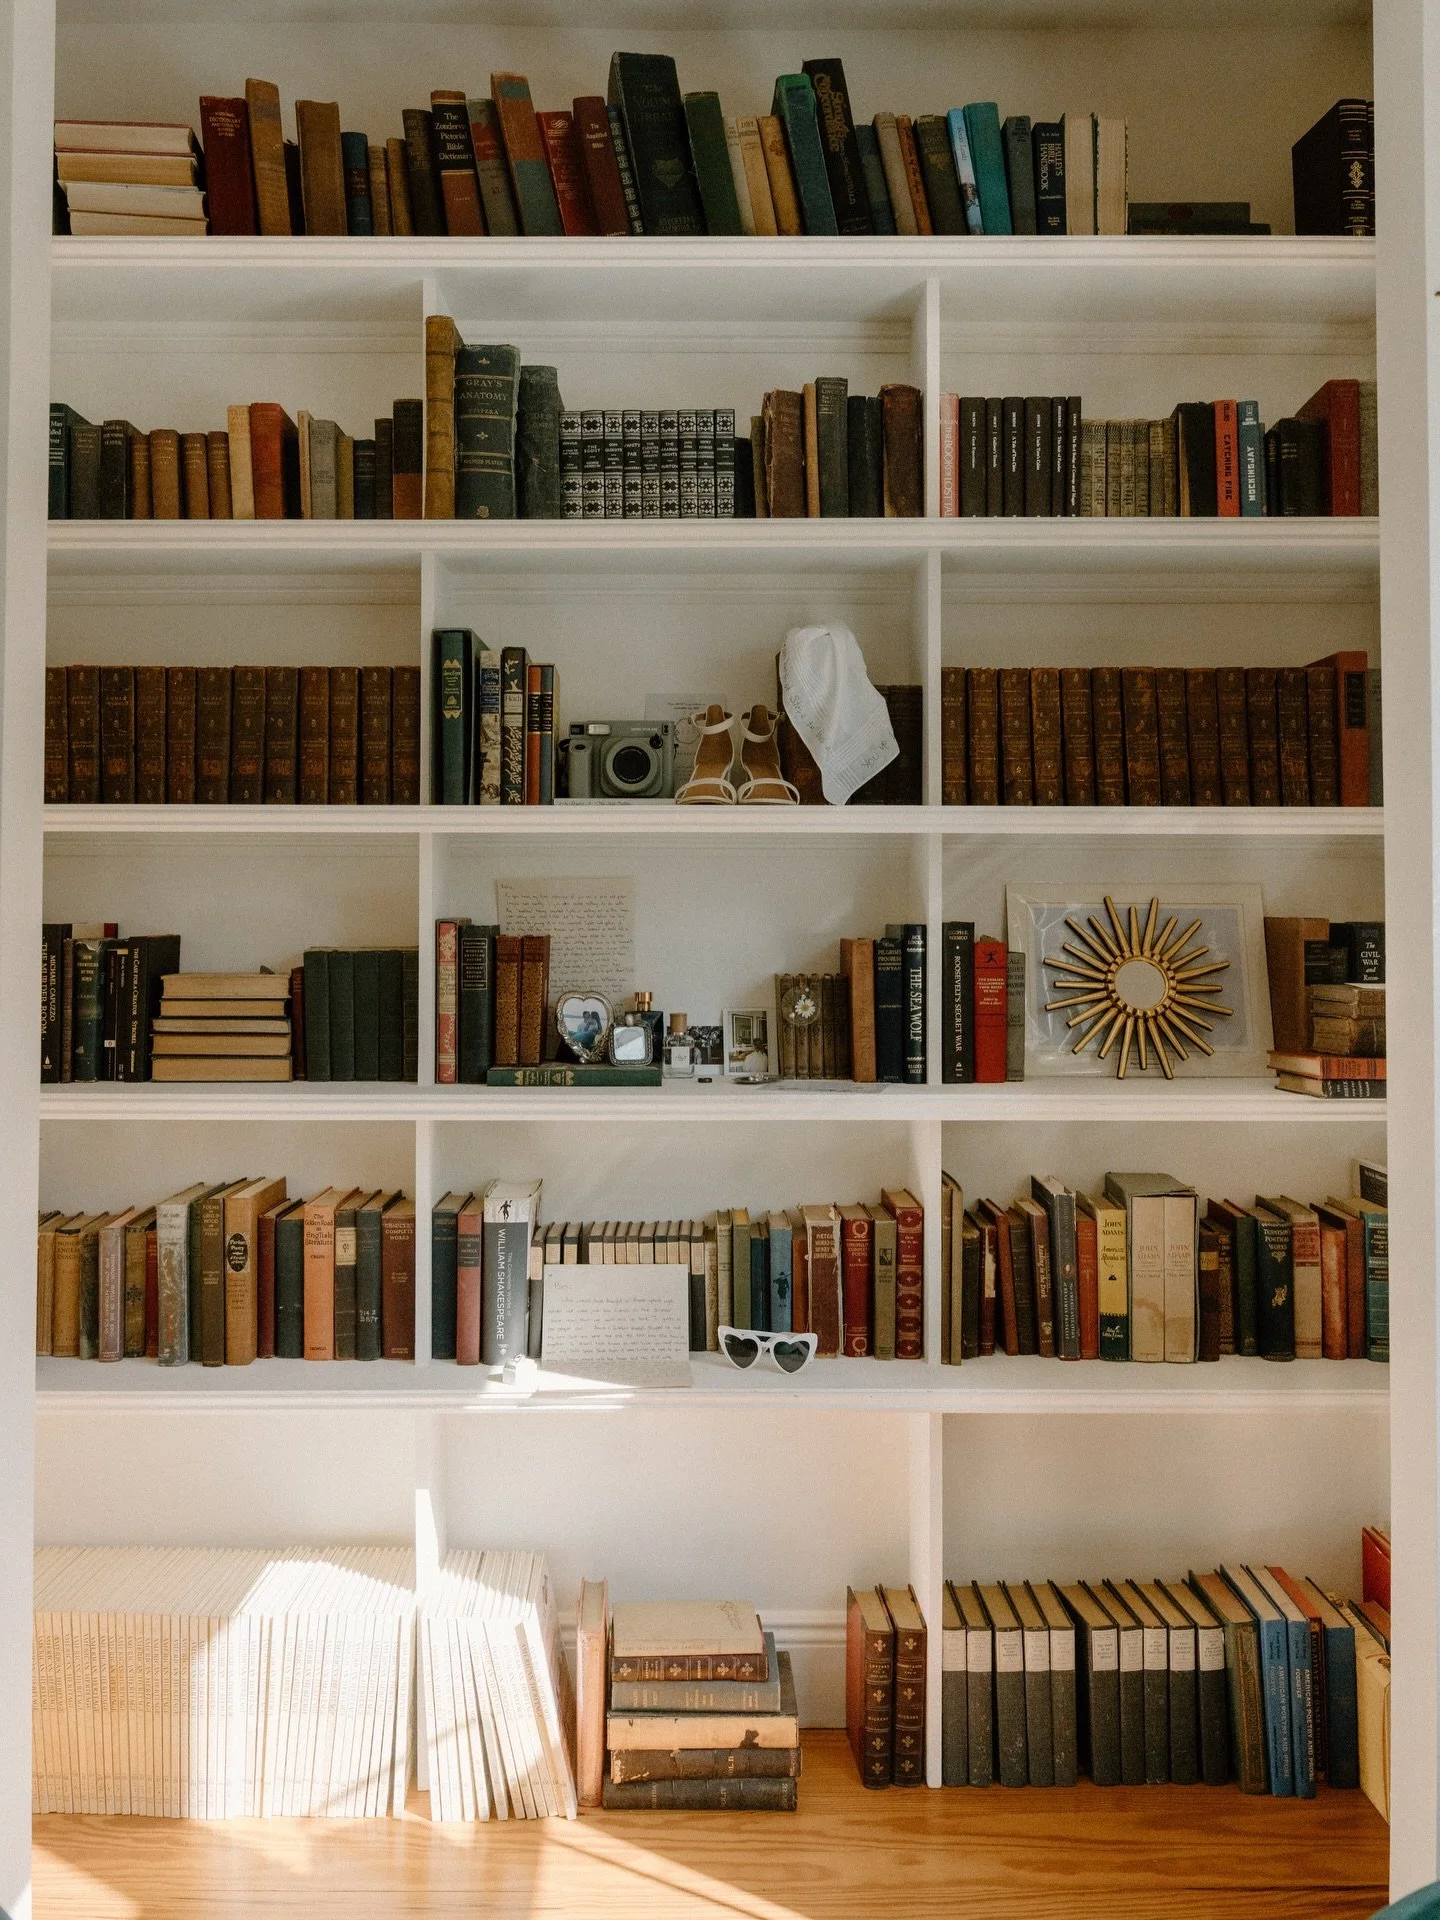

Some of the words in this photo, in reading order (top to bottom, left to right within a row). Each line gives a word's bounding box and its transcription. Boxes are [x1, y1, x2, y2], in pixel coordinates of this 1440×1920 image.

[443, 112, 459, 121] The
[446, 142, 465, 151] Bible
[1040, 143, 1049, 192] HANDBOOK
[460, 391, 510, 402] ANATOMY
[466, 379, 503, 388] GRAY'S
[1223, 434, 1232, 478] CATCHING
[942, 477, 953, 500] LOST
[1247, 446, 1257, 502] MOCKINGJAY
[41, 963, 49, 1003] MURDER
[910, 966, 923, 990] THE
[131, 990, 139, 1015] CREATOR
[910, 991, 923, 1012] SEA
[41, 1005, 50, 1035] ROOM
[910, 1012, 923, 1042] WOLF
[306, 1230, 333, 1240] English
[1103, 1219, 1121, 1228] JOHN
[497, 1229, 506, 1270] WILLIAM
[496, 1271, 505, 1340] SHAKESPEARE
[1069, 1290, 1077, 1339] AMERICANIZATION
[1277, 1665, 1286, 1704] AMERICAN
[1304, 1668, 1312, 1706] AMERICAN
